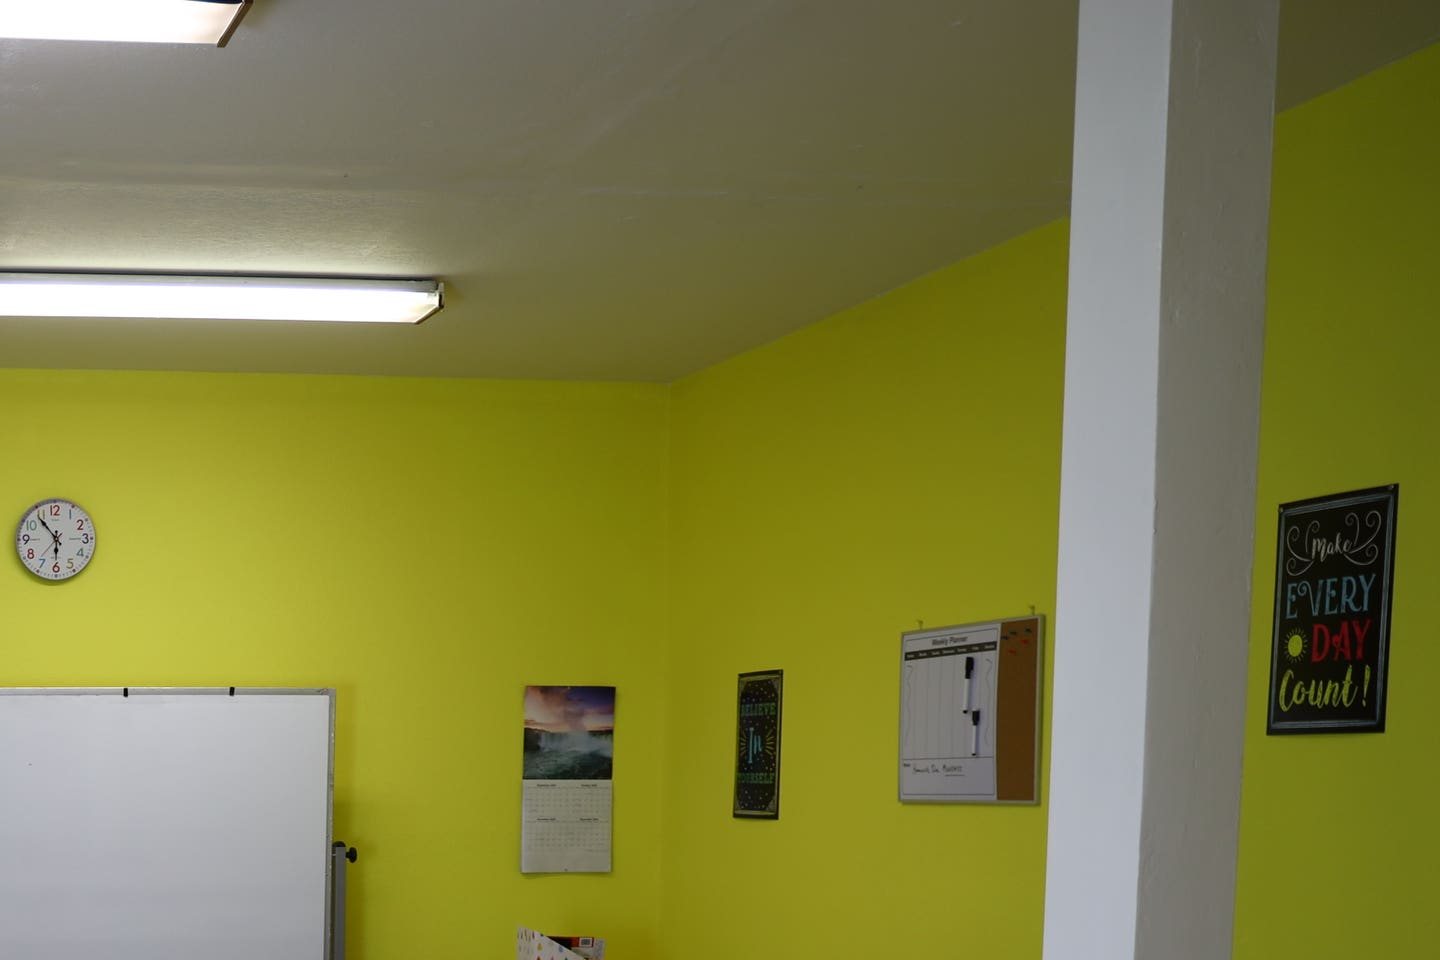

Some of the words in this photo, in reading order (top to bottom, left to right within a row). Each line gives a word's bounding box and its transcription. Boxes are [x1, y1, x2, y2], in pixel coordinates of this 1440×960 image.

[50, 505, 60, 516] 12
[26, 521, 37, 530] 10
[76, 519, 84, 530] 2
[22, 534, 30, 545] 9
[82, 533, 89, 544] 3
[76, 547, 84, 557] 4
[1310, 531, 1353, 563] Make
[27, 548, 34, 559] 8
[39, 558, 46, 568] 7
[52, 562, 60, 573] 6
[66, 558, 74, 569] 5
[1285, 573, 1376, 620] EVERY
[1310, 619, 1371, 663] DAY
[1278, 664, 1371, 713] Count!
